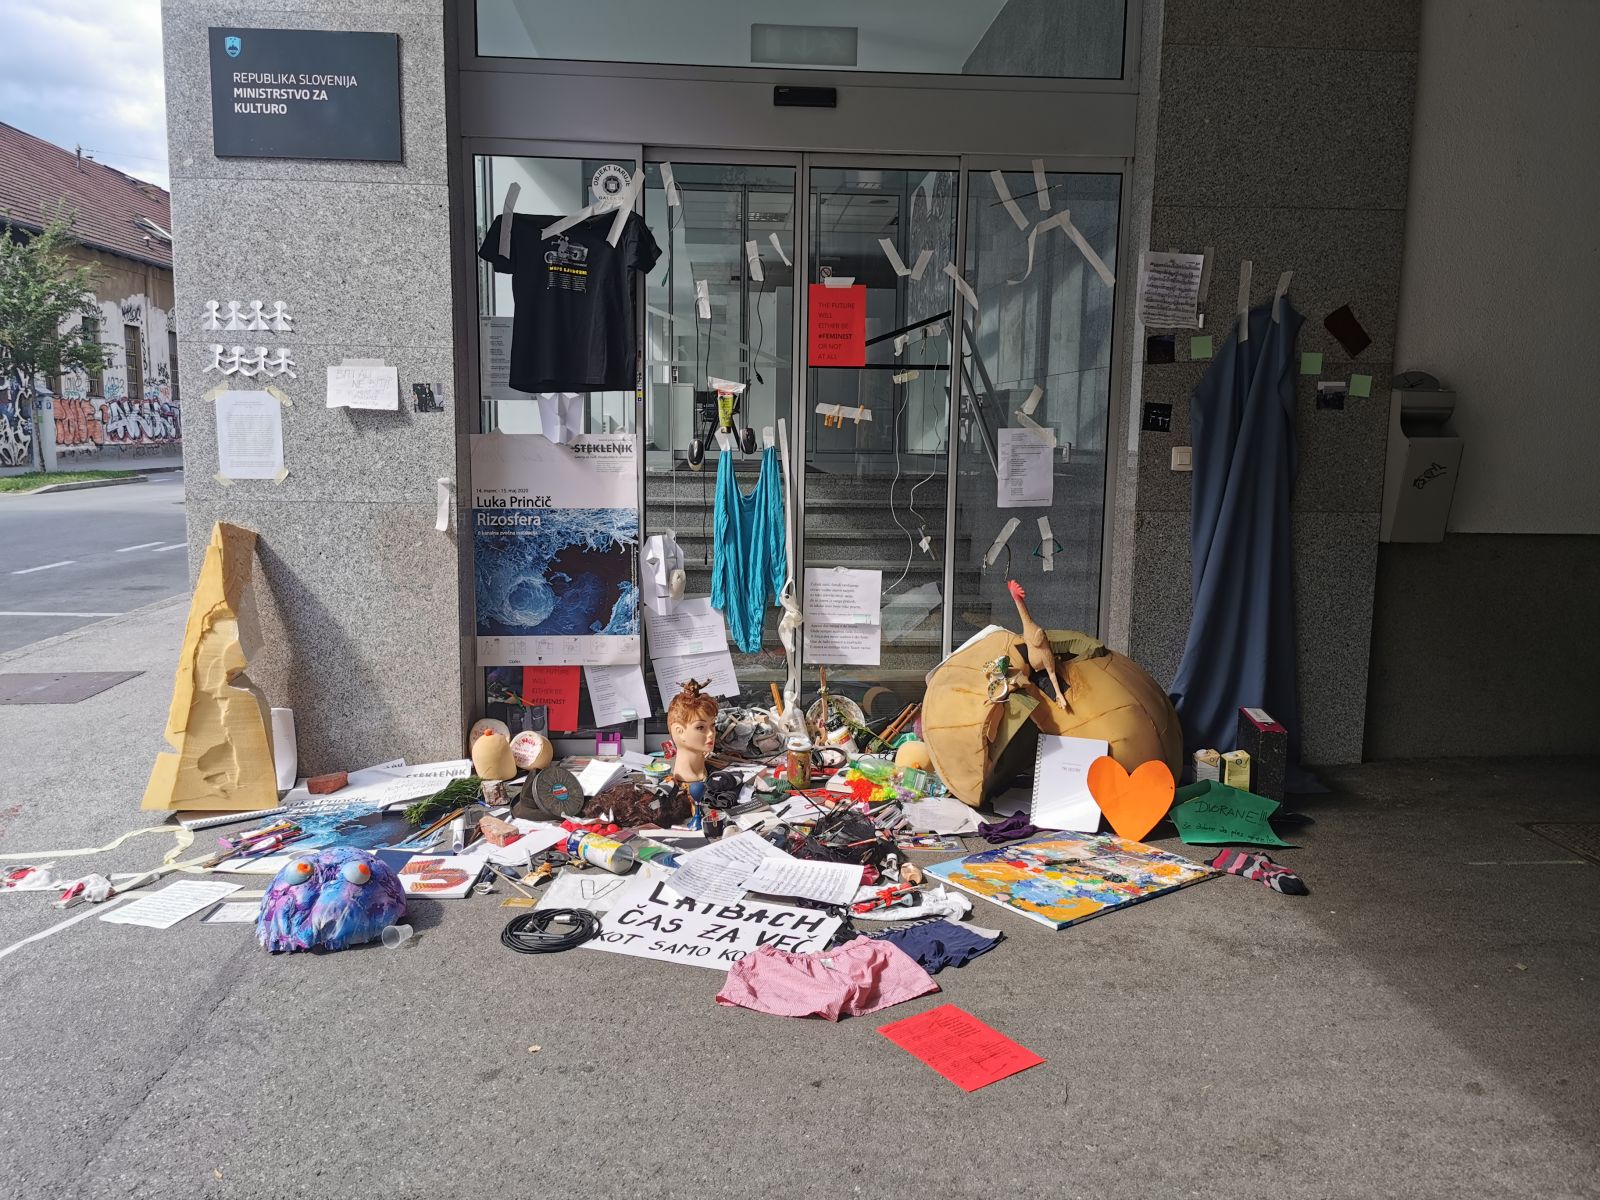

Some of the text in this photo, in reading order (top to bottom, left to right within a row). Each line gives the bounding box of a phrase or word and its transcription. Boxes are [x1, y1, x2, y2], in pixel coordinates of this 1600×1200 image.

[233, 72, 358, 88] REPUBLIKA SLOVENIJA
[233, 88, 328, 100] MINISTRSTVO ZA
[234, 103, 287, 114] KULTURO
[593, 166, 630, 187] OBJEKT VARUJE
[574, 443, 633, 455] STEKLENIK
[476, 495, 552, 508] Luka Prinčič
[477, 512, 541, 526] Rizosfera
[648, 881, 827, 932] LAIBACH
[617, 904, 684, 933] ČAS
[697, 923, 741, 943] ZA
[595, 930, 748, 962] KOT SAMO KO
